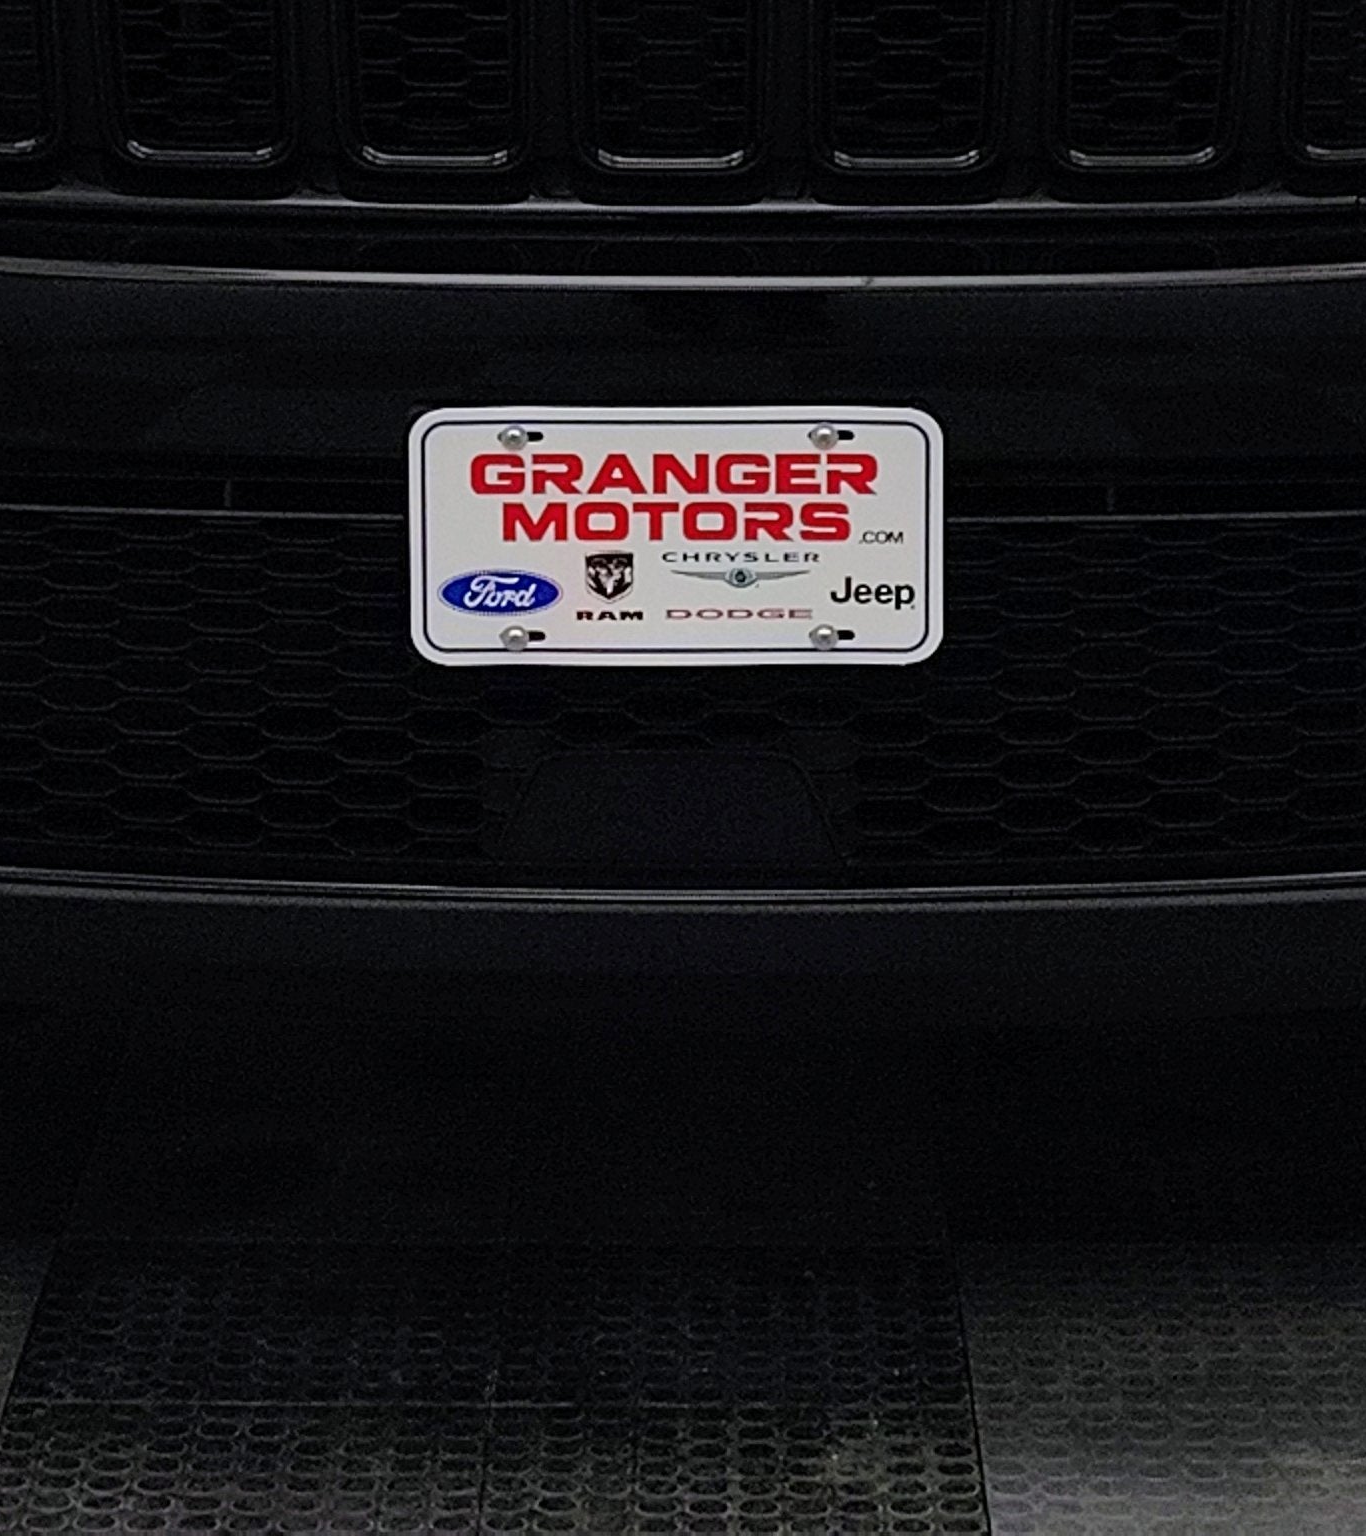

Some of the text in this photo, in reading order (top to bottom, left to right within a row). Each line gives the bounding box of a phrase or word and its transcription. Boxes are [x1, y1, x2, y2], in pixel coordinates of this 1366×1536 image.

[469, 453, 879, 495] GRANGER
[502, 501, 852, 542] MOTORS
[661, 551, 822, 564] CHRYSLER
[464, 575, 537, 609] Ford
[830, 576, 916, 610] Jeep
[575, 610, 644, 622] RAM
[665, 608, 814, 621] DODGE
